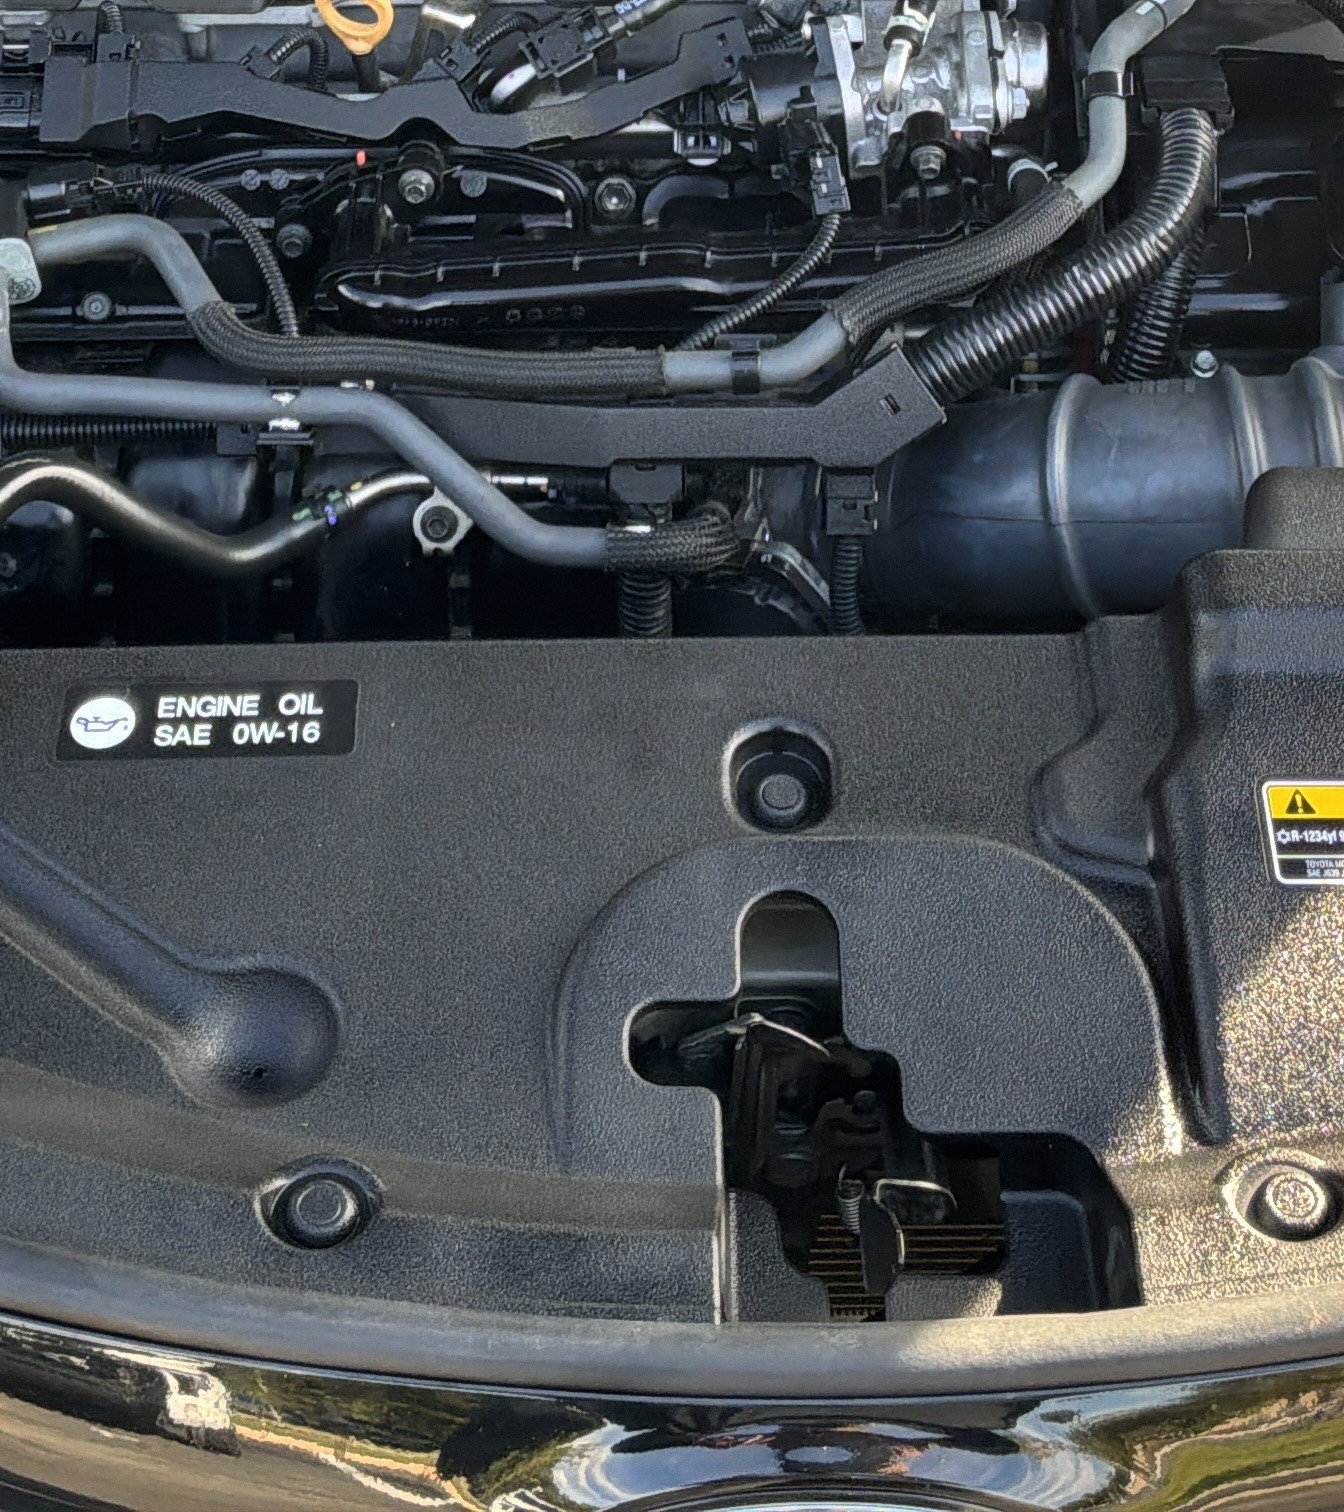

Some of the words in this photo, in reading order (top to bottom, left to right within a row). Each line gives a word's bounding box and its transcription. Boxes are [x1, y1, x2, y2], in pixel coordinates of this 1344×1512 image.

[157, 693, 261, 719] ENGINE
[278, 692, 324, 716] OIL
[153, 723, 213, 747] SAE
[232, 721, 321, 745] 0W-16
[1305, 859, 1334, 868] TOYOTA
